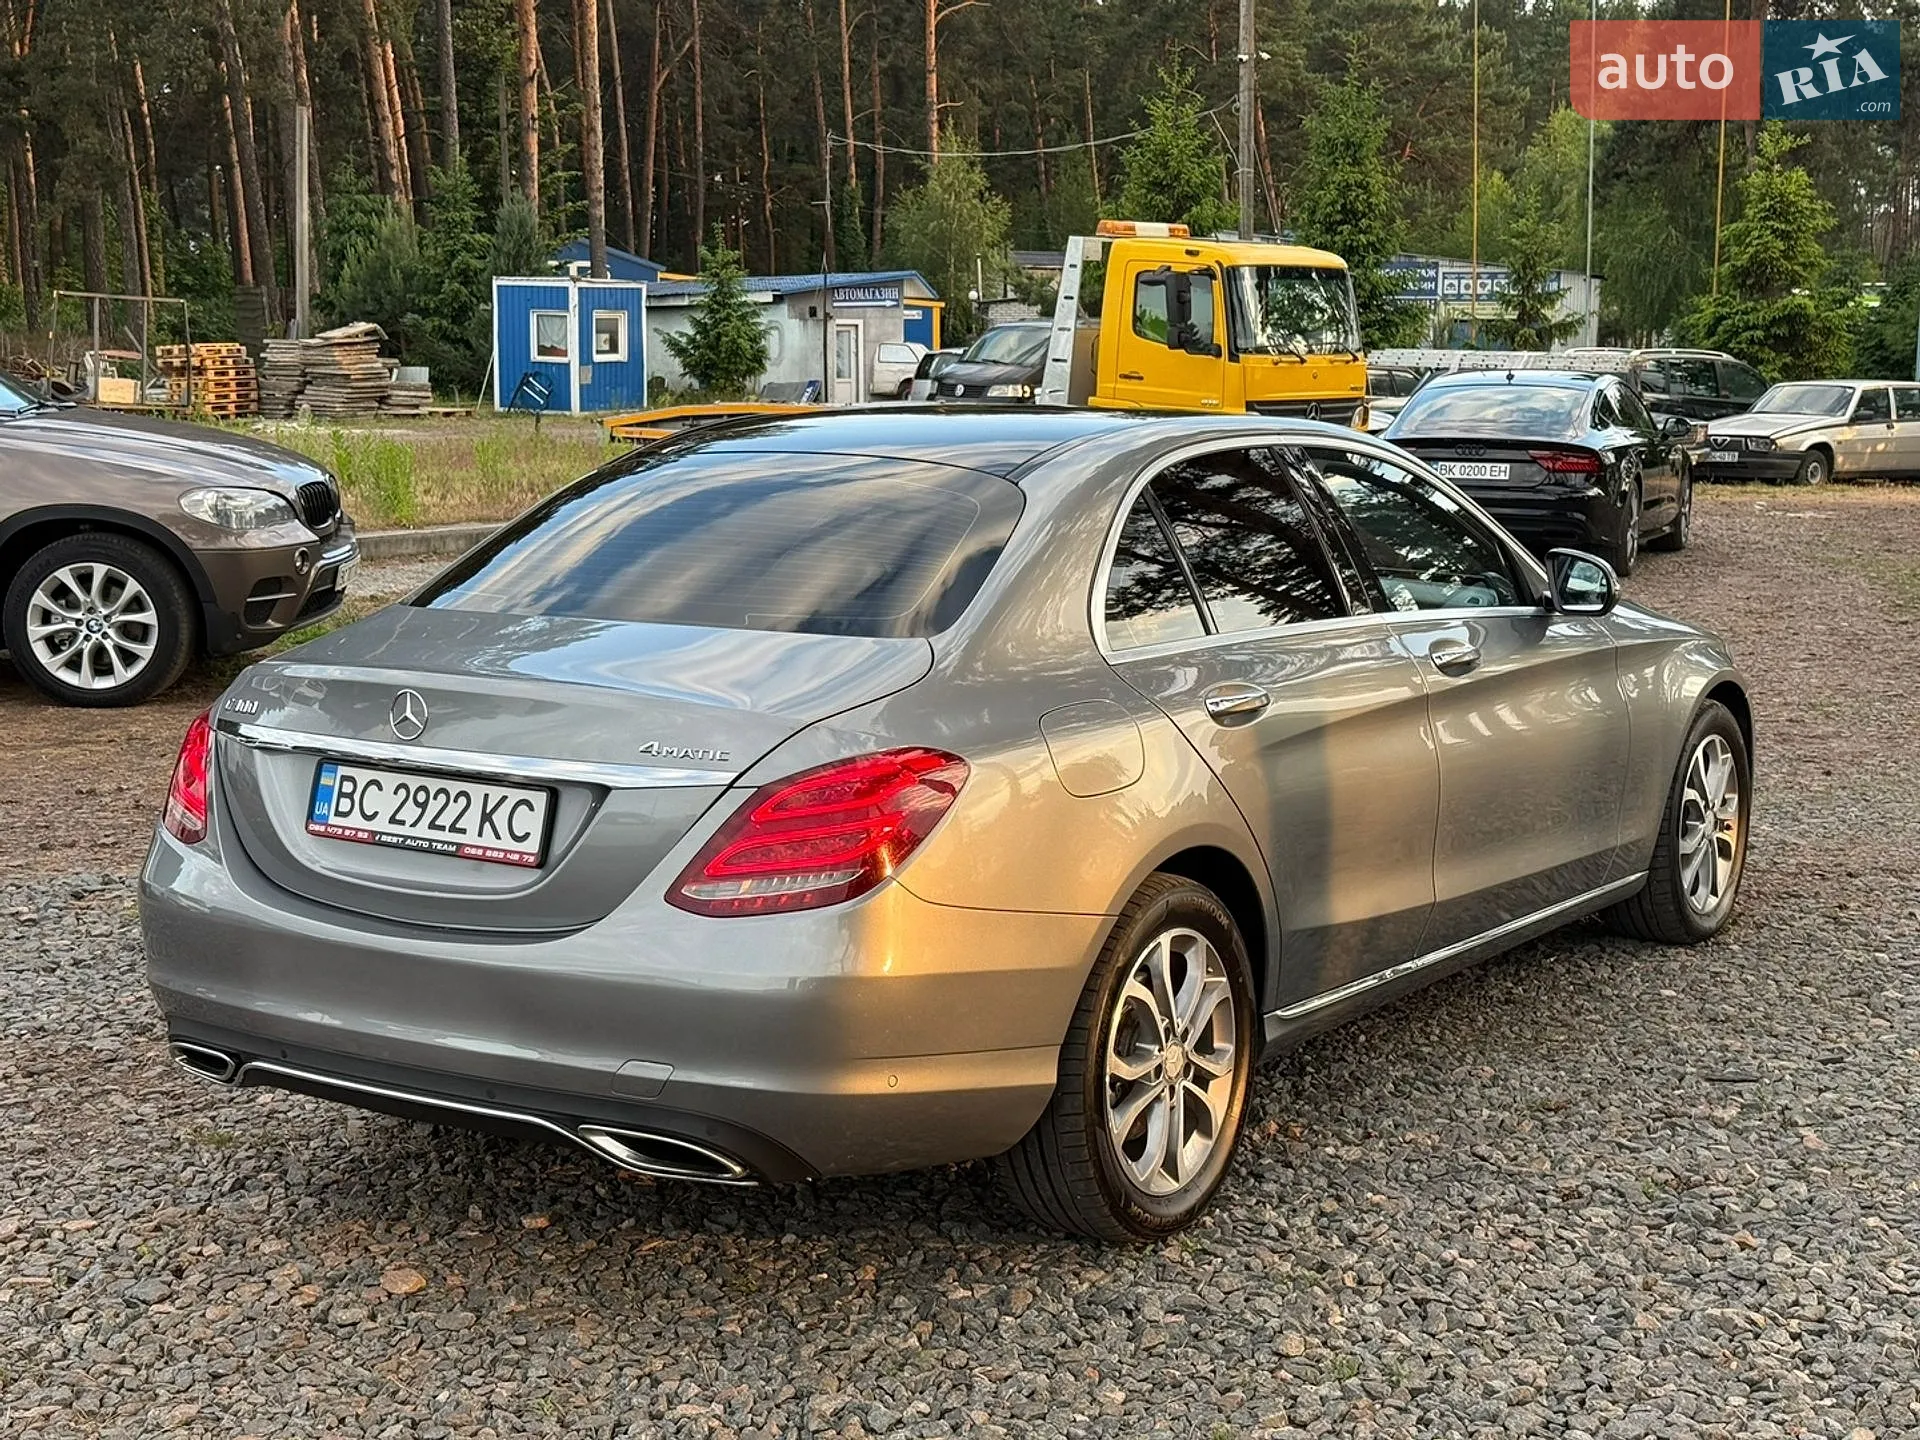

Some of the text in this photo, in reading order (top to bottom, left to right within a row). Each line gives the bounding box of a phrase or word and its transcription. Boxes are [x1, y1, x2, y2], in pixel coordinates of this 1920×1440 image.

[832, 287, 899, 300] АВТОМАГАЗИН
[1439, 463, 1508, 478] BK 0200 EH
[638, 740, 731, 762] 4MATIC
[315, 801, 329, 817] UA
[333, 774, 536, 843] BC 2922 KC
[381, 834, 404, 844] BEST
[405, 839, 429, 848] AUTO
[431, 842, 458, 852] TEAM
